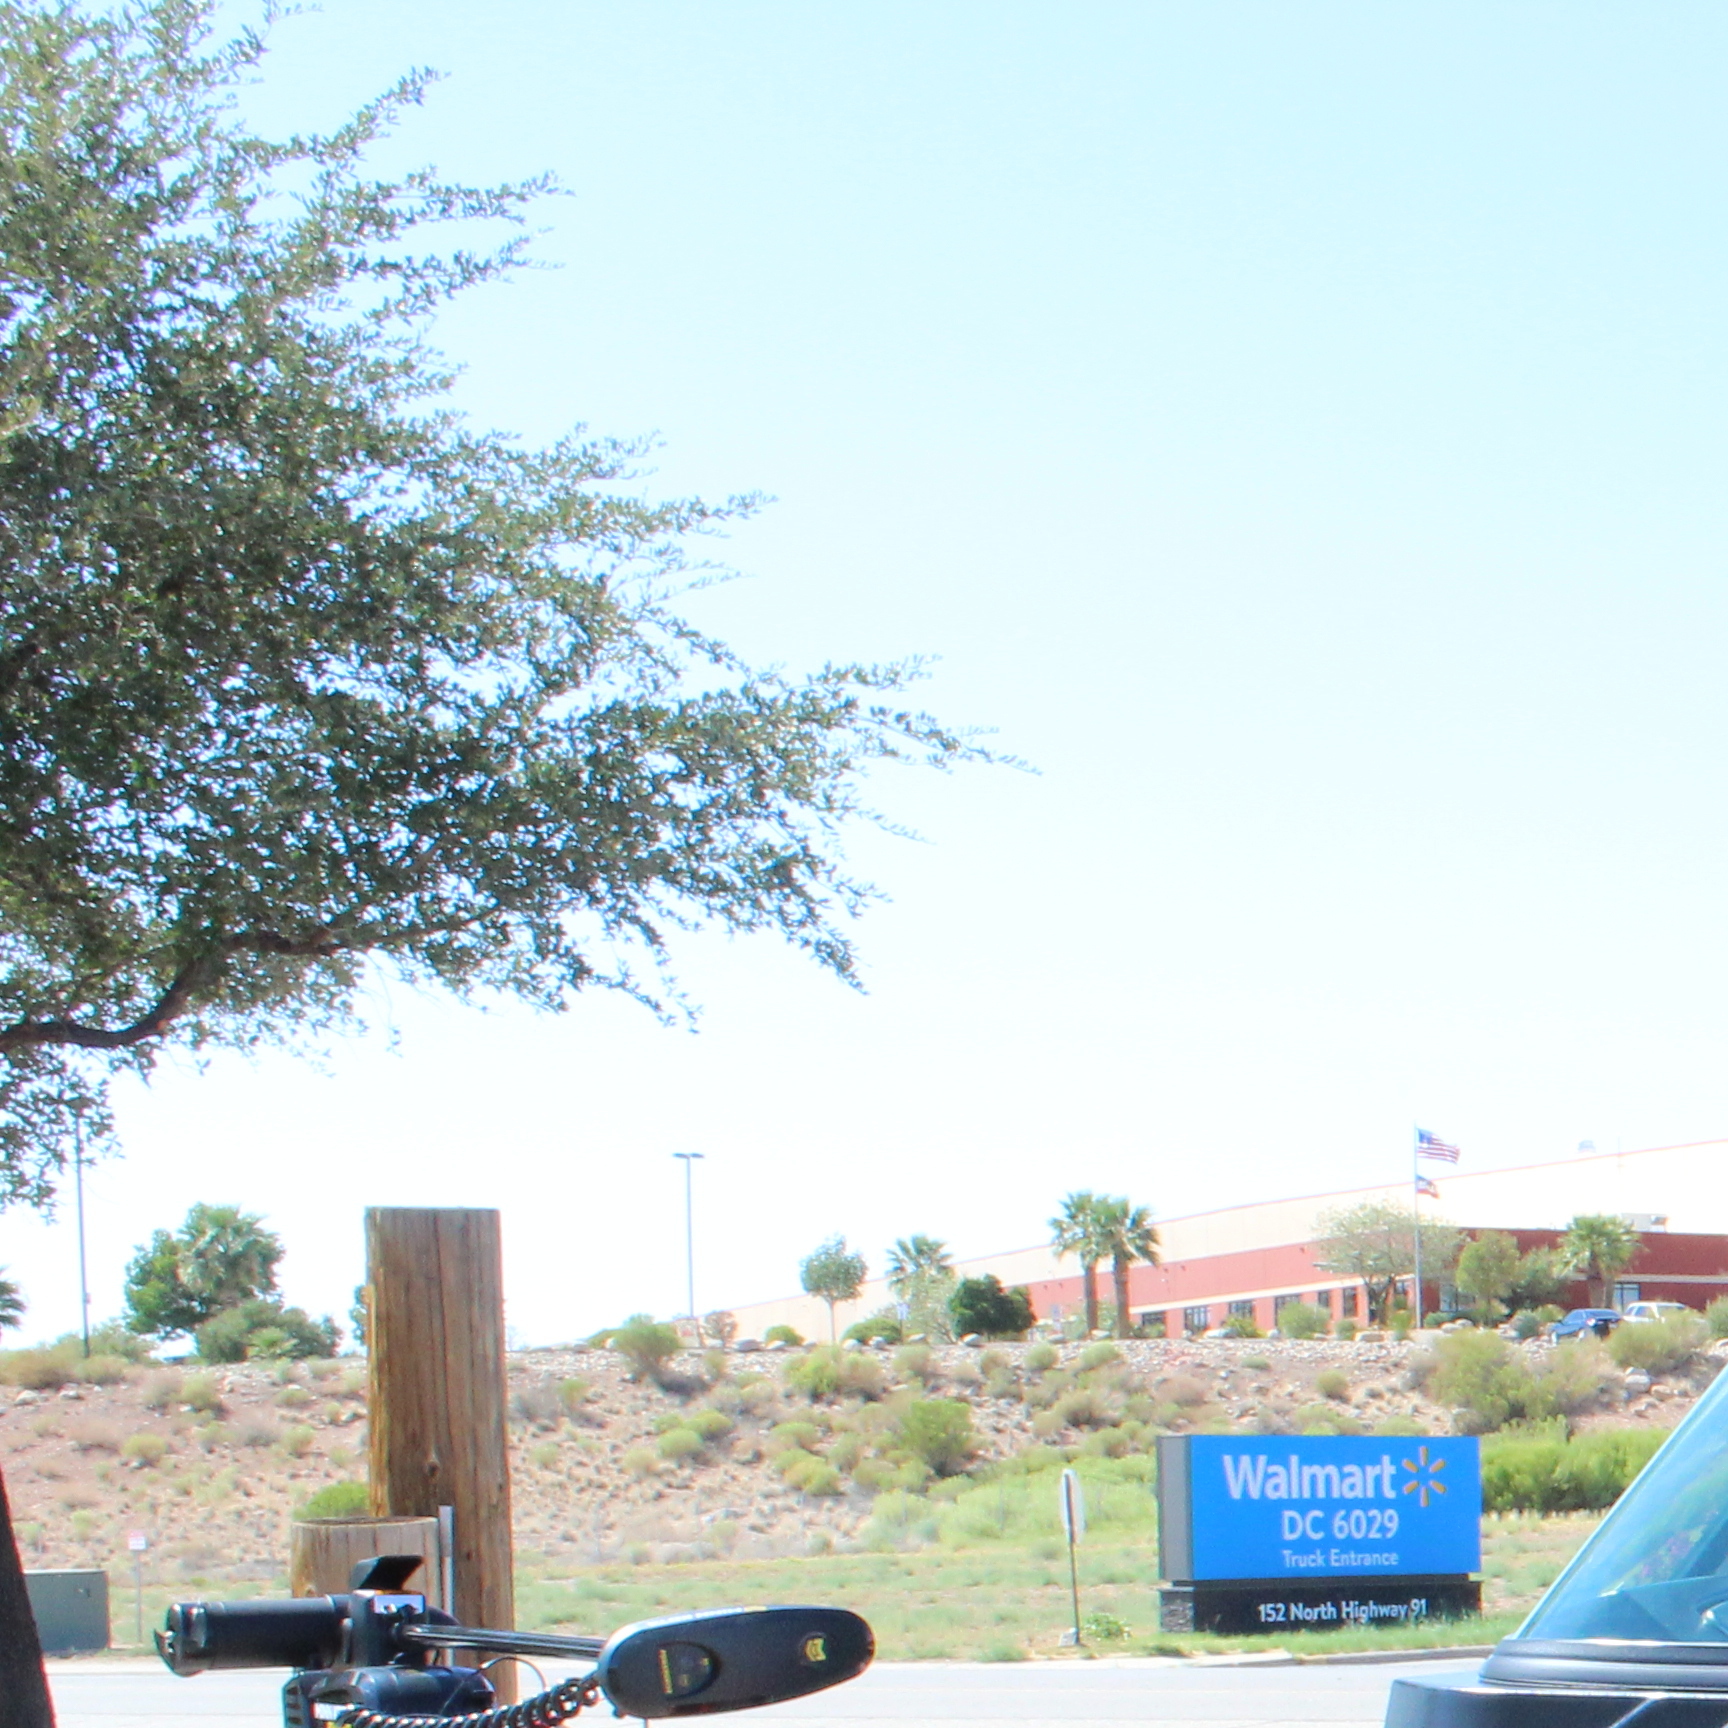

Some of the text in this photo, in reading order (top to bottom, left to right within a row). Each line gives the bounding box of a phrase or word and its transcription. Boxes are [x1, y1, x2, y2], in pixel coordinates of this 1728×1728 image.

[1223, 1454, 1397, 1500] Walmart
[1282, 1509, 1399, 1541] DC 6029
[1283, 1549, 1399, 1567] Truck Entrance
[1259, 1599, 1427, 1624] 152 North Highway 91
